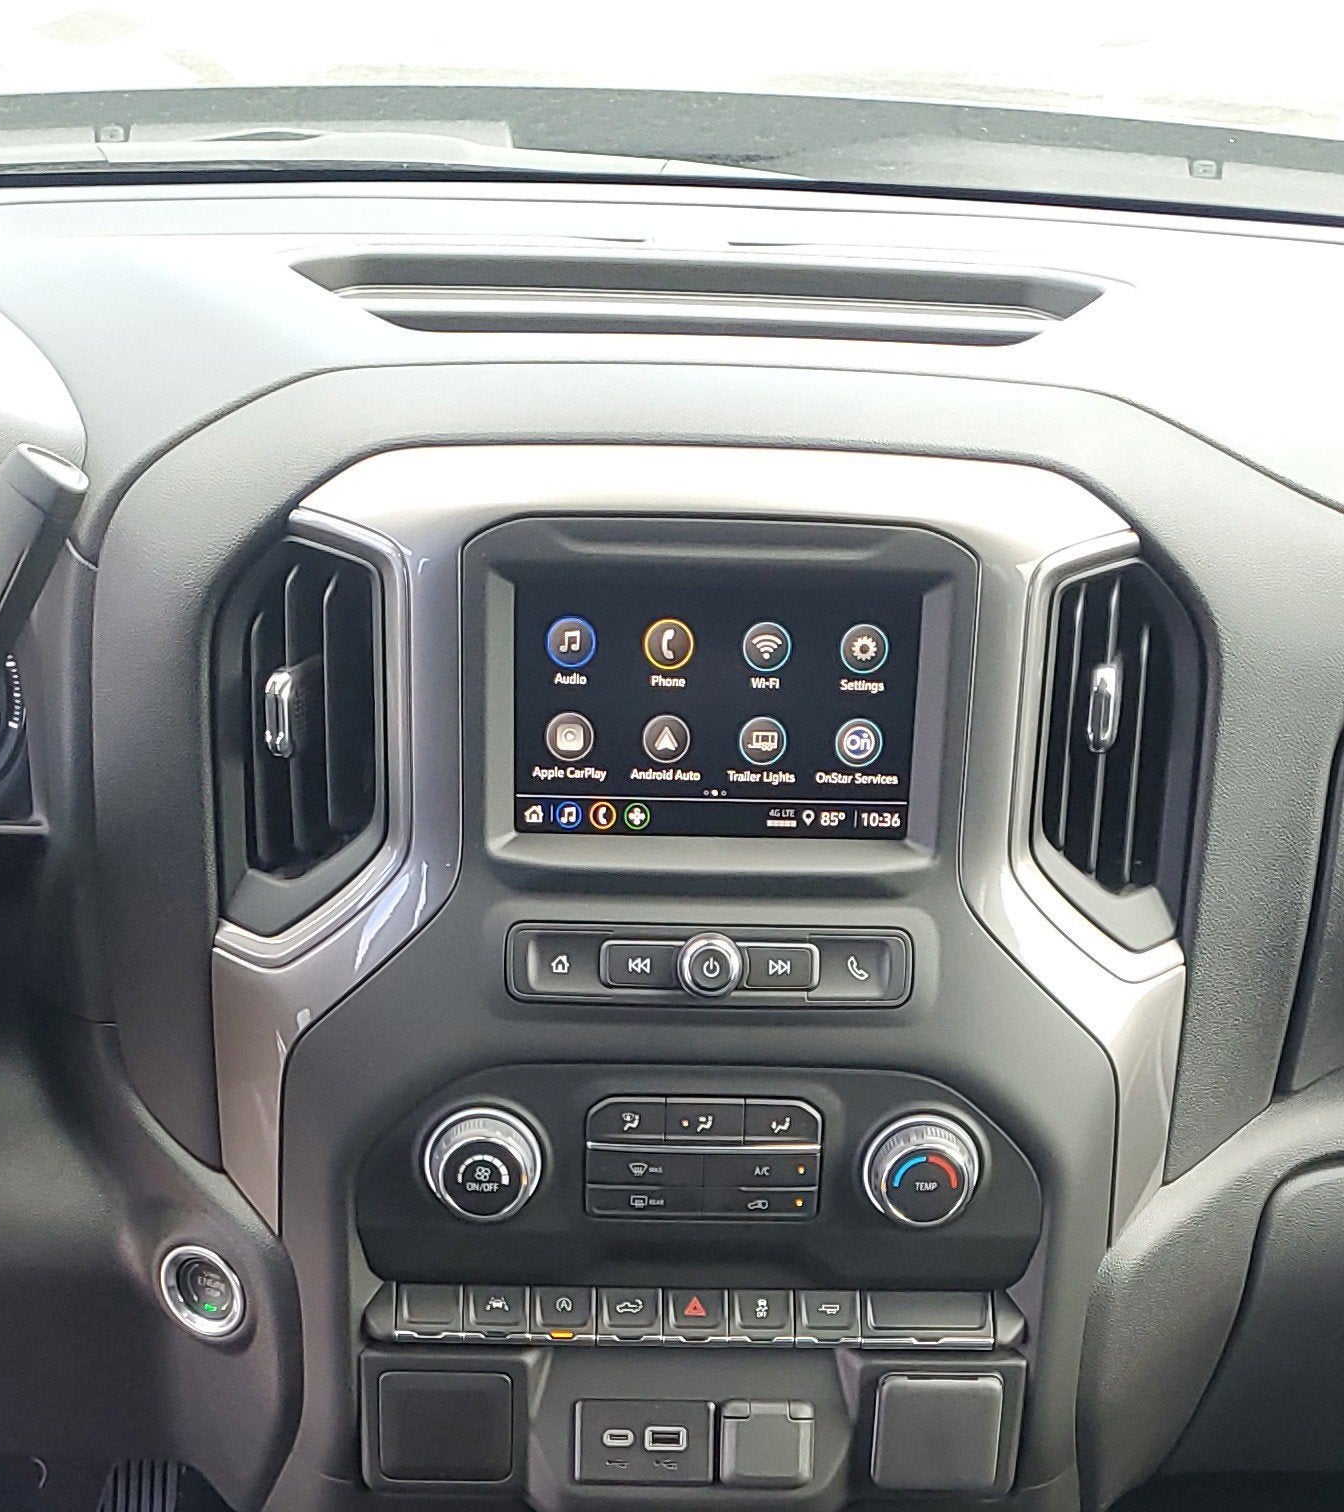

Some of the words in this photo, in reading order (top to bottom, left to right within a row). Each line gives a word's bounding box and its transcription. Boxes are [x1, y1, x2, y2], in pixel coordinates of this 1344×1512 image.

[554, 672, 588, 685] Audio
[650, 675, 687, 688] Phone
[750, 677, 780, 689] Wi-Fi
[839, 679, 885, 693] Settings
[532, 766, 564, 780] Apple
[566, 767, 607, 782] CarPlay
[630, 768, 674, 781] Android
[674, 769, 701, 781] Auto
[727, 770, 761, 783] Trailer
[763, 771, 796, 785] Lights
[815, 772, 854, 784] OnStar
[854, 773, 899, 785] Services
[768, 809, 781, 817] 4G
[781, 809, 796, 818] LTE
[861, 812, 901, 827] 10:36
[754, 1166, 771, 1176] A/C
[466, 1182, 499, 1192] ON/OFF
[914, 1181, 938, 1191] TEMP
